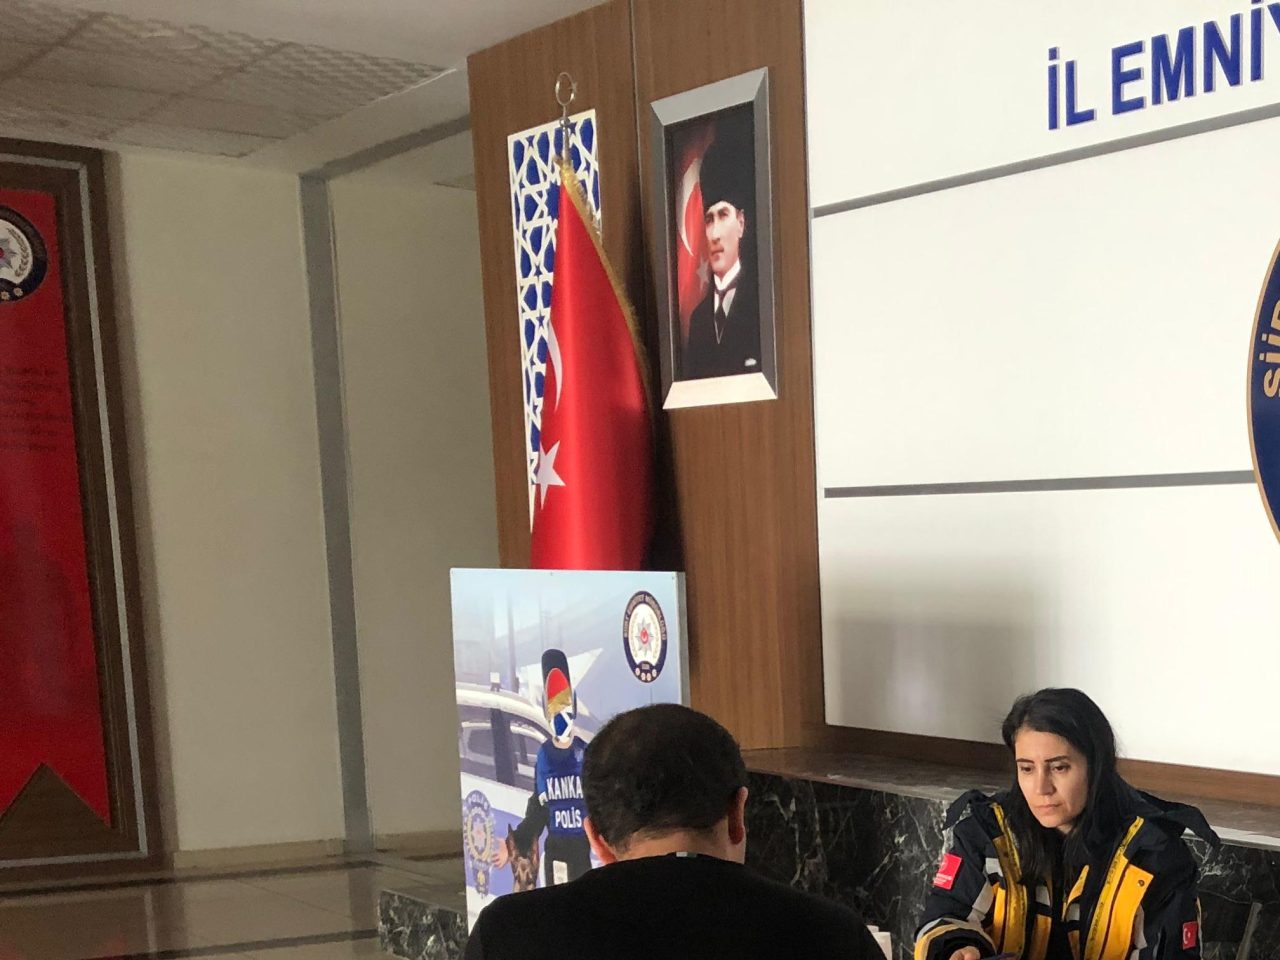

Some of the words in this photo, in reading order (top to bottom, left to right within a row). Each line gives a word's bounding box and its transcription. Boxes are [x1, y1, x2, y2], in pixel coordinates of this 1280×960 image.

[1048, 47, 1095, 130] İL
[546, 776, 583, 800] KANKA
[555, 807, 581, 829] POLİS
